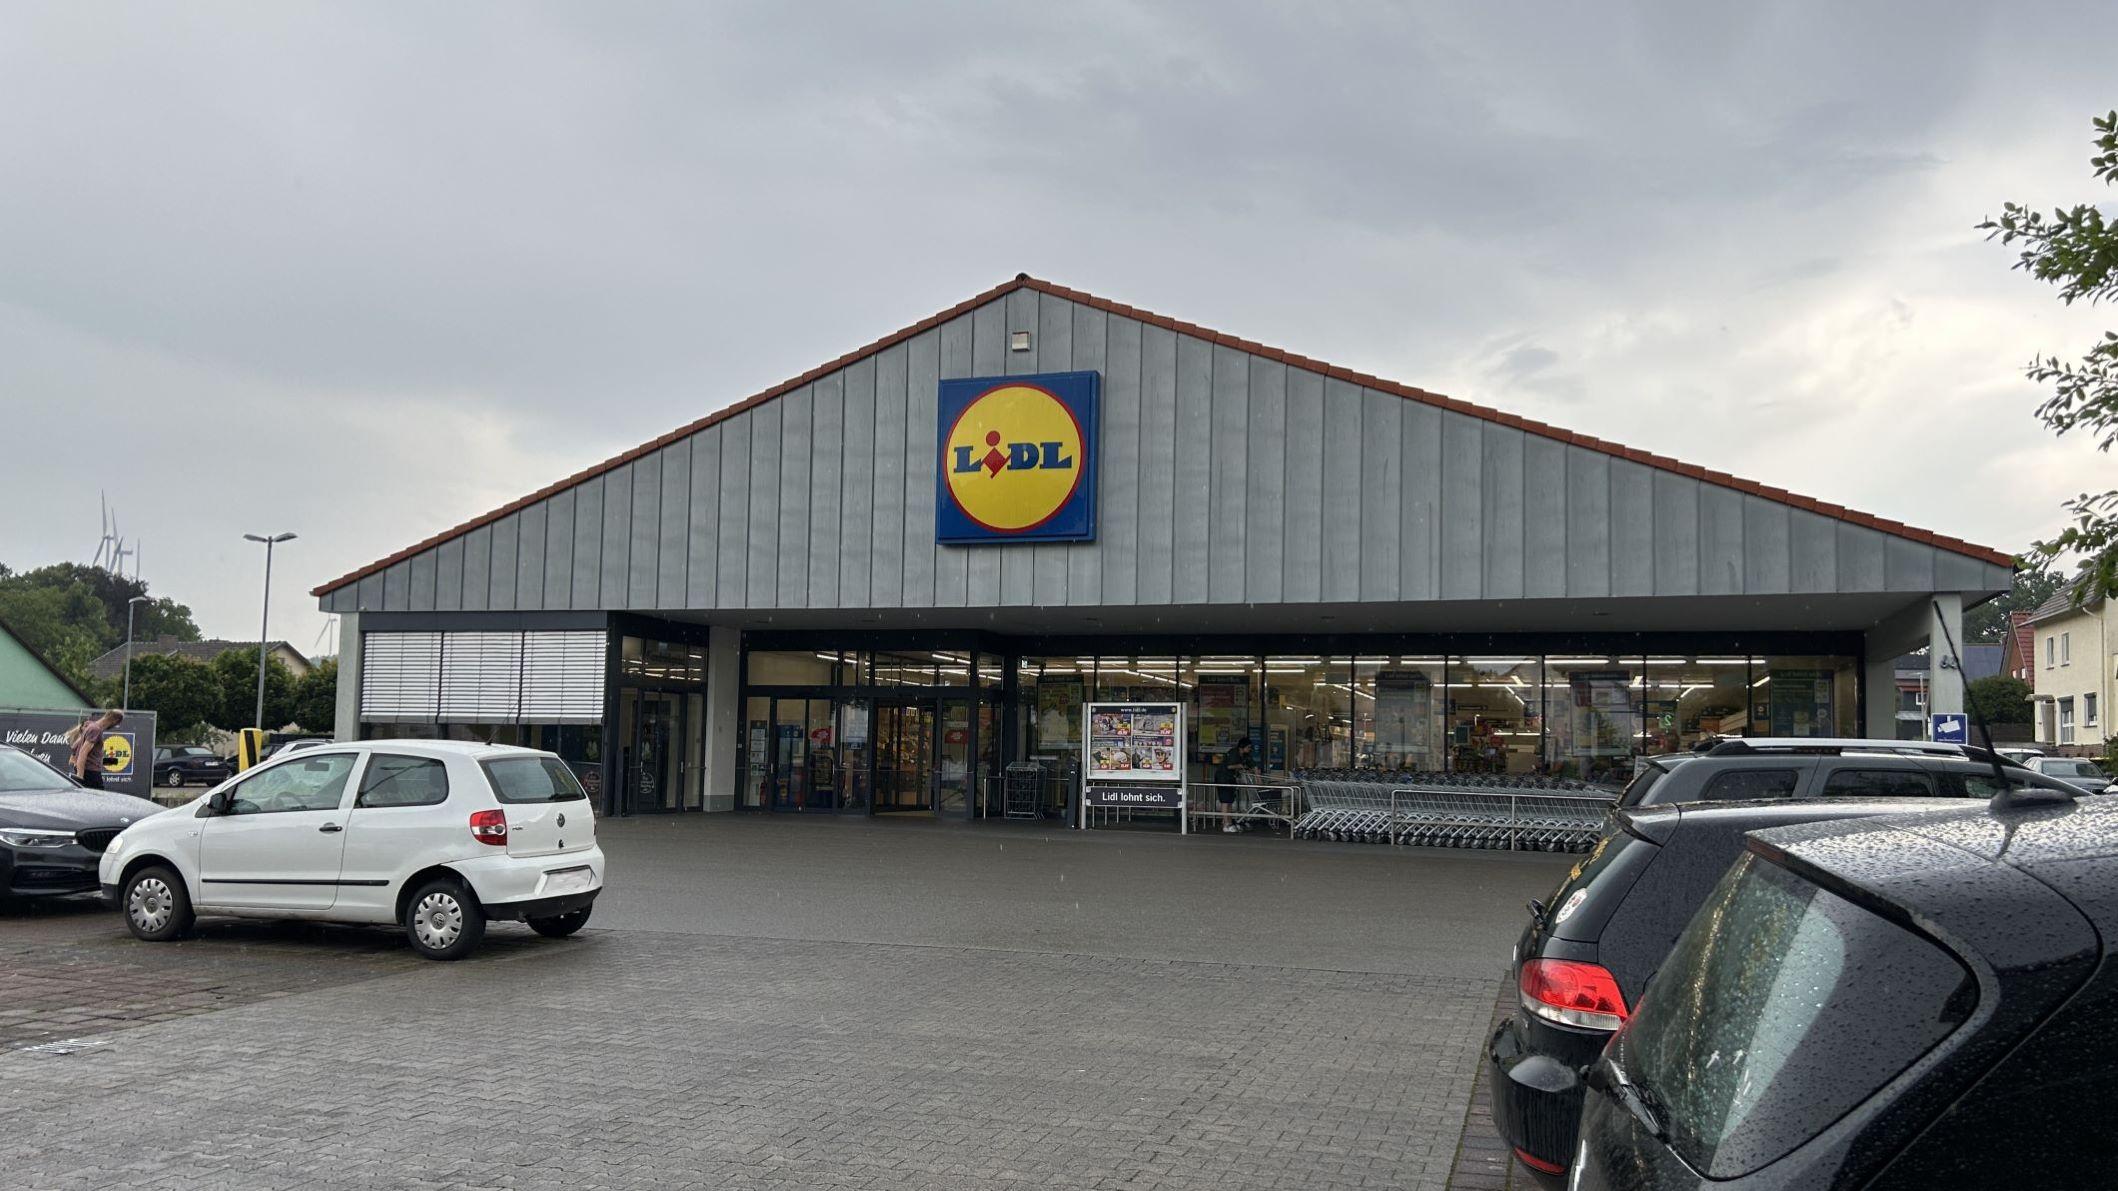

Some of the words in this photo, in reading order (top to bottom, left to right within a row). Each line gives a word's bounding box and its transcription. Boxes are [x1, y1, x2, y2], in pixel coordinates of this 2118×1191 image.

[6, 729, 39, 743] Vielen
[1102, 792, 1118, 801] Lidl
[1120, 793, 1143, 802] lohnt
[1145, 793, 1166, 802] sich.
